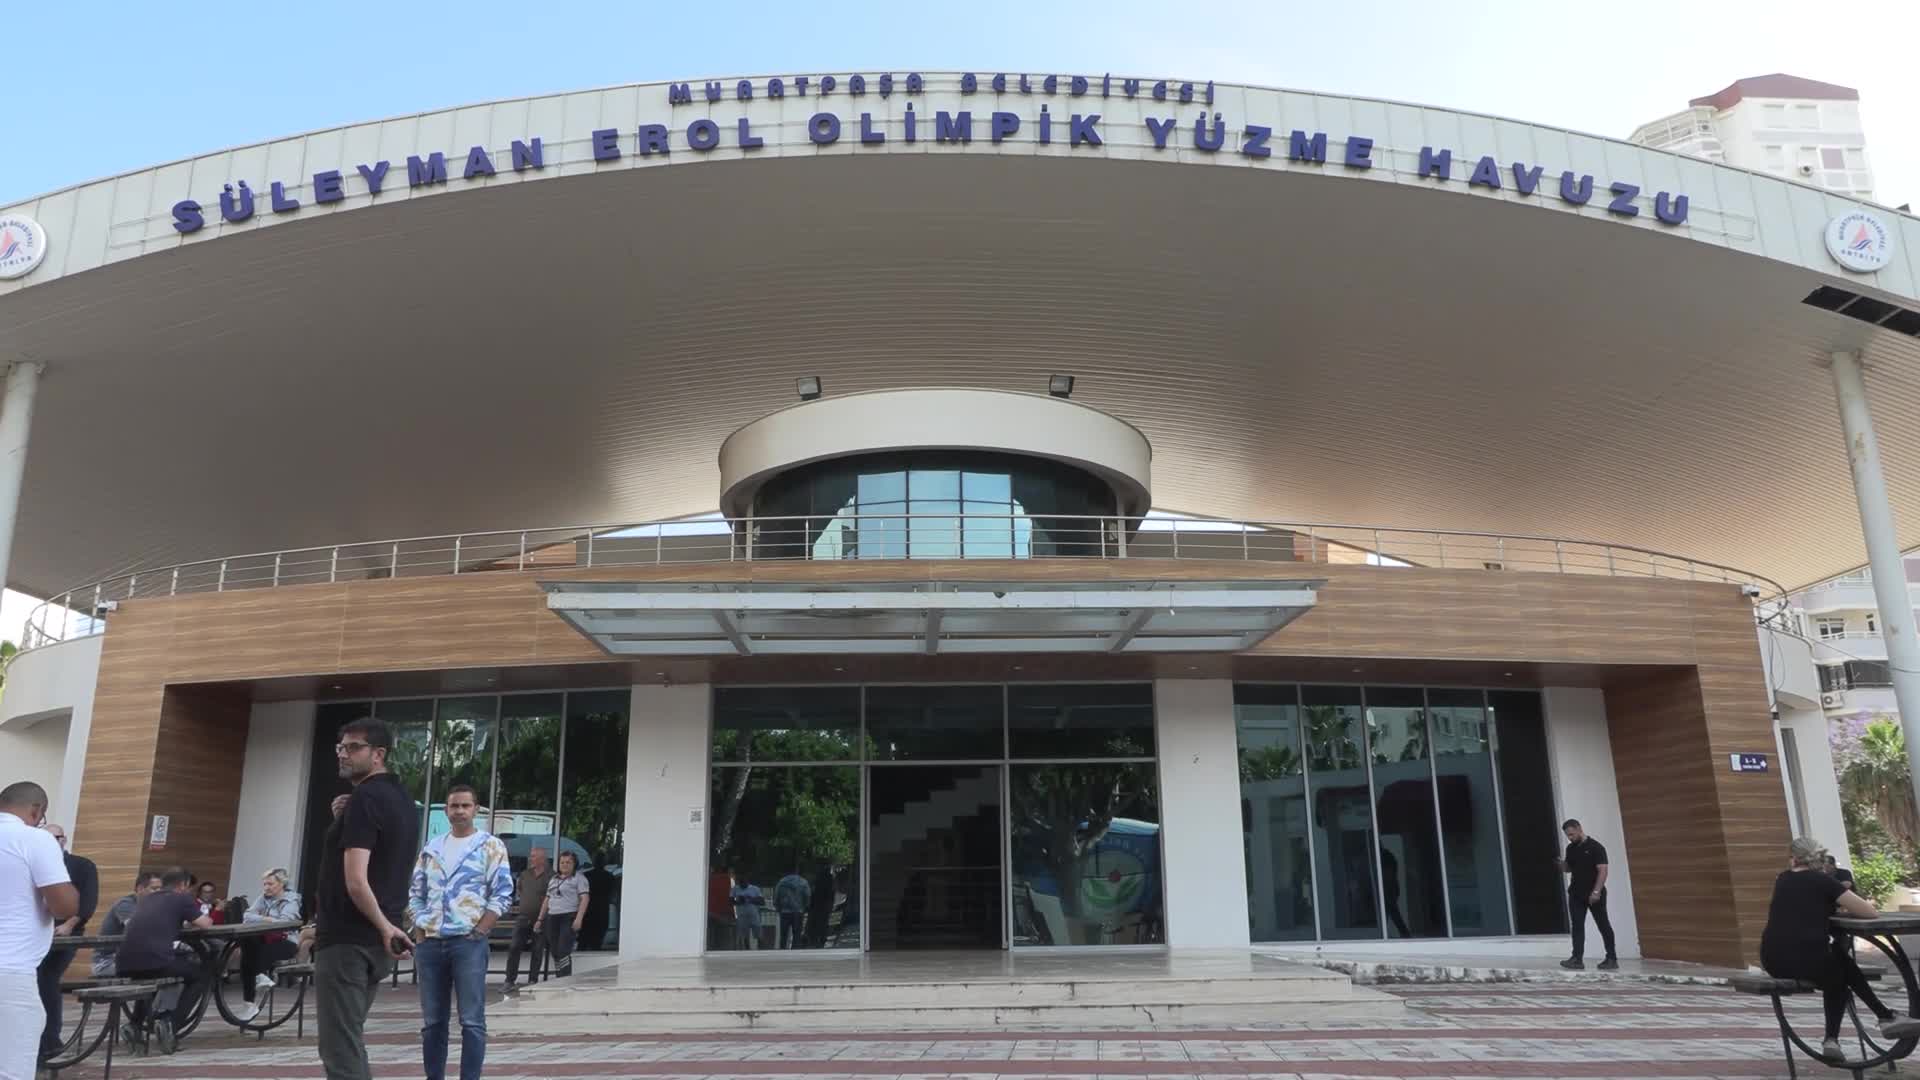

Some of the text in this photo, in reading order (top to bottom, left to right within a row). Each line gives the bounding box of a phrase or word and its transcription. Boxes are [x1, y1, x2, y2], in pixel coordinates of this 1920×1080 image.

[668, 71, 1215, 105] MURATPAŞA BELEDİYESİ
[171, 102, 1690, 233] SÜLEYMAN EROL OLİMPİK YÜZME HAVUZU
